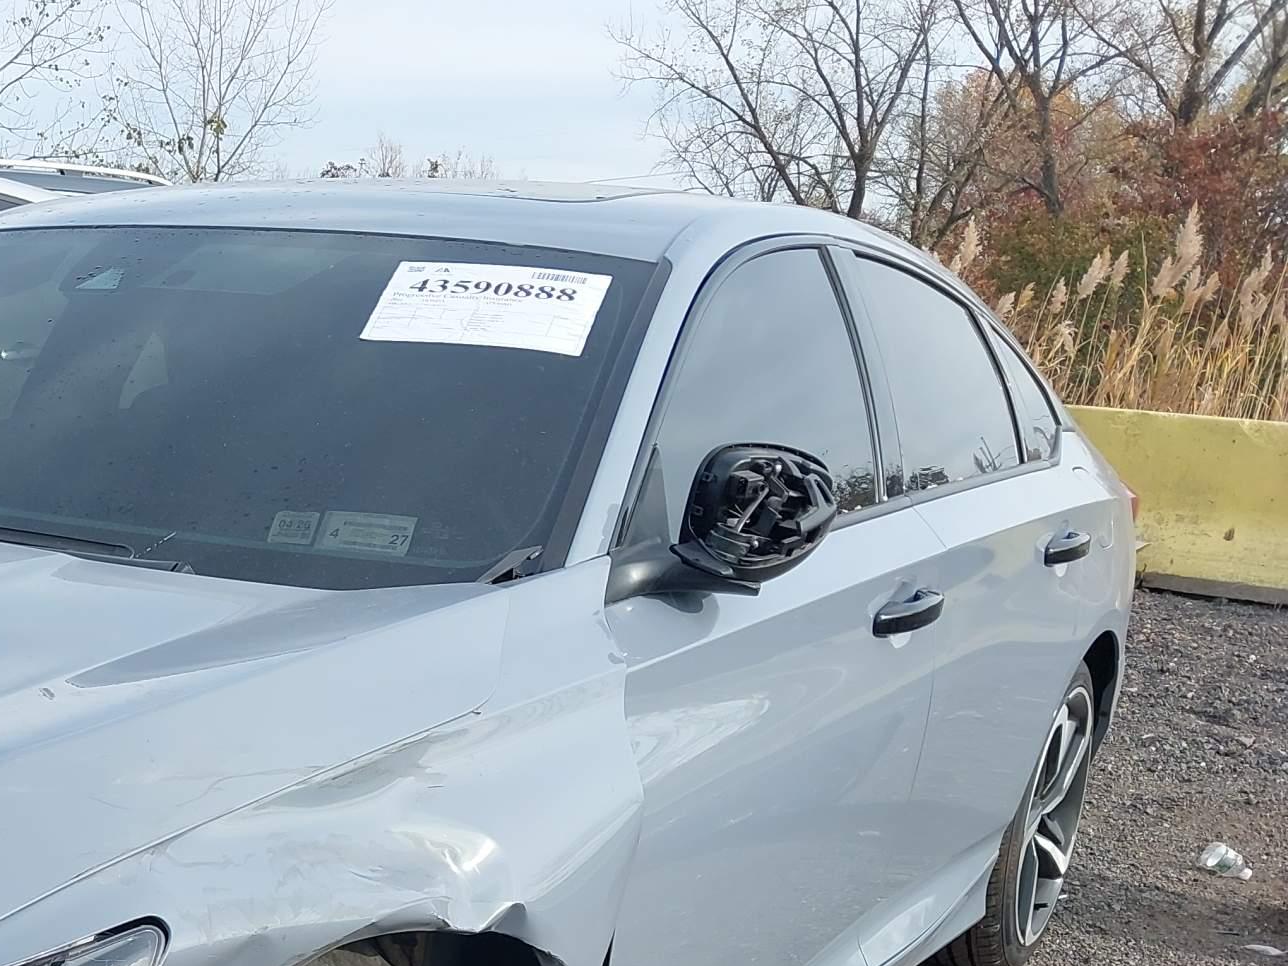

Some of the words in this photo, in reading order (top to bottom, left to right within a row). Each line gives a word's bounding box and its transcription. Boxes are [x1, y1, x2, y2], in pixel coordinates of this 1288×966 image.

[409, 278, 577, 301] 43590888
[328, 528, 341, 539] 4
[389, 534, 409, 546] 27
